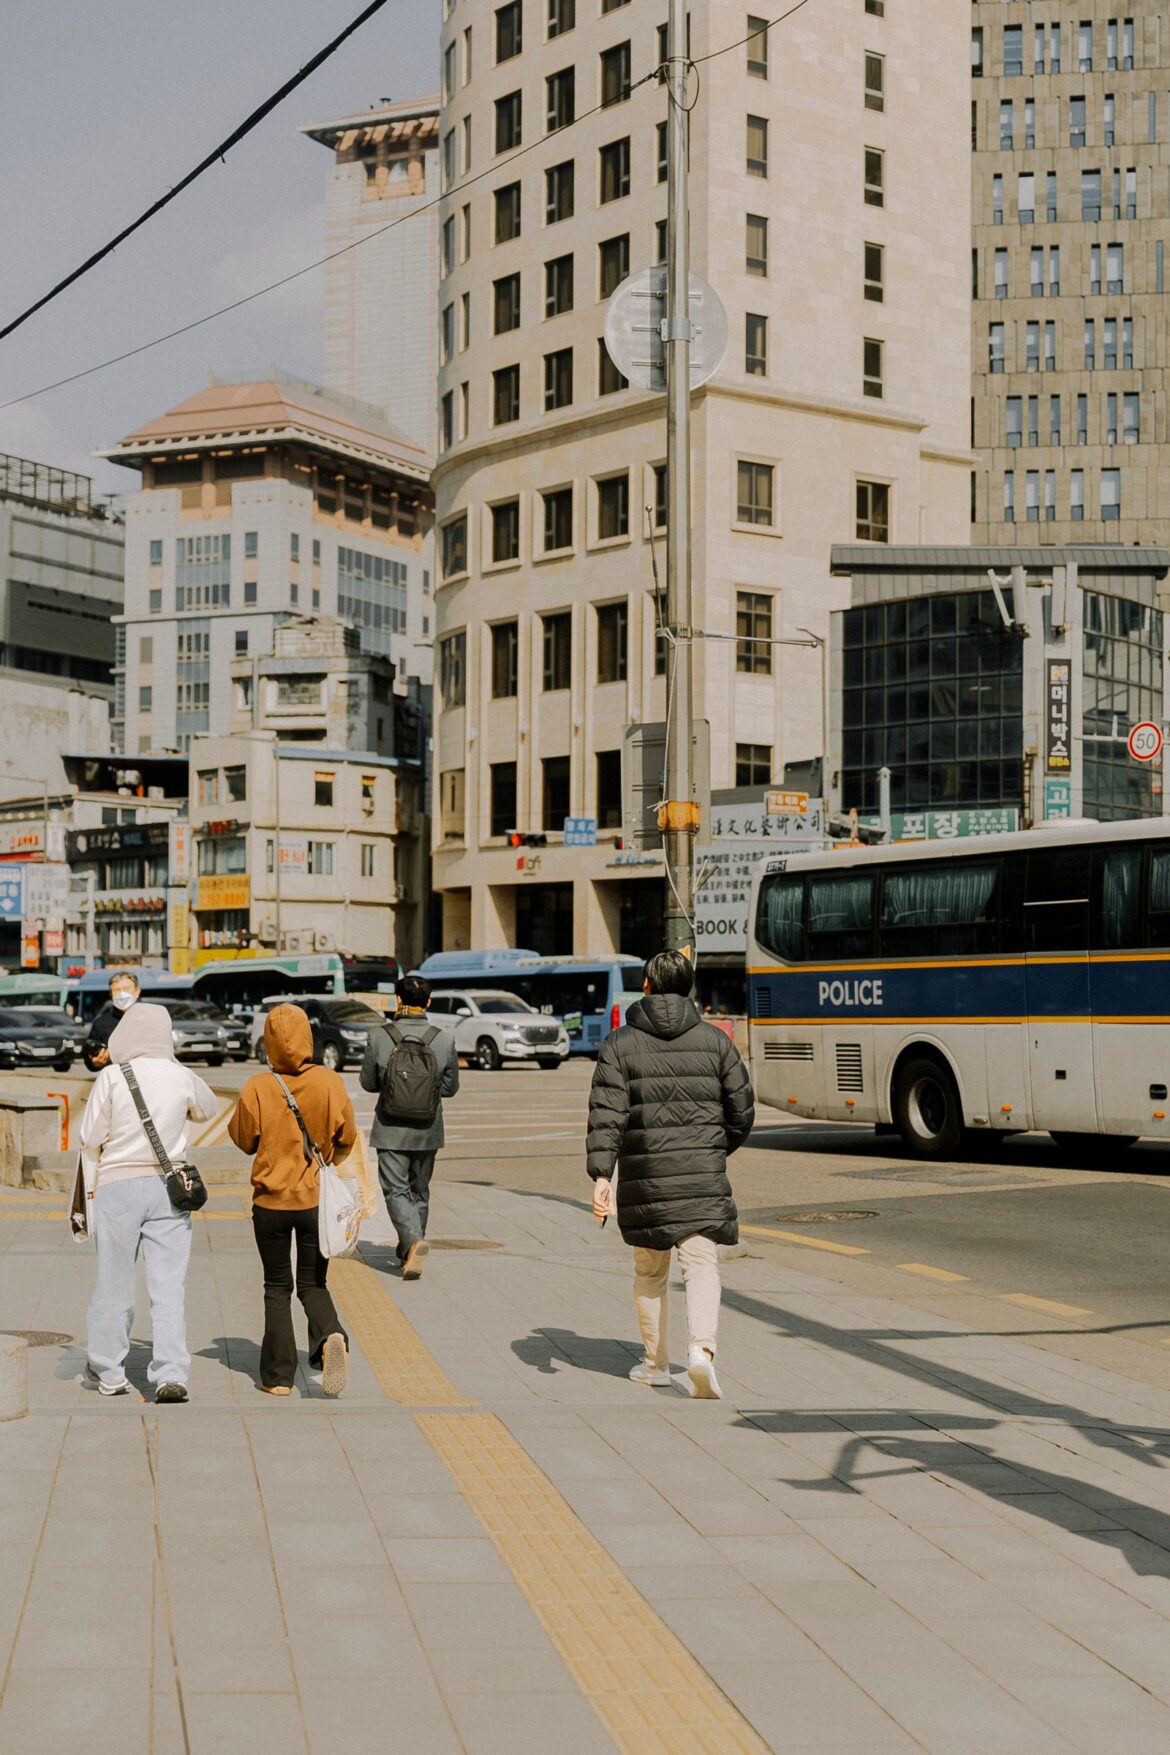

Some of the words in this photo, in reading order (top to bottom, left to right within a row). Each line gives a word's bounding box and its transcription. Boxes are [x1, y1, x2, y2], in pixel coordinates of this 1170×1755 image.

[1051, 685, 1068, 756] 머니박스
[1136, 733, 1155, 749] 50
[696, 920, 737, 935] BOOK
[819, 980, 883, 1006] POLICE
[146, 1126, 172, 1170] BURBERRY
